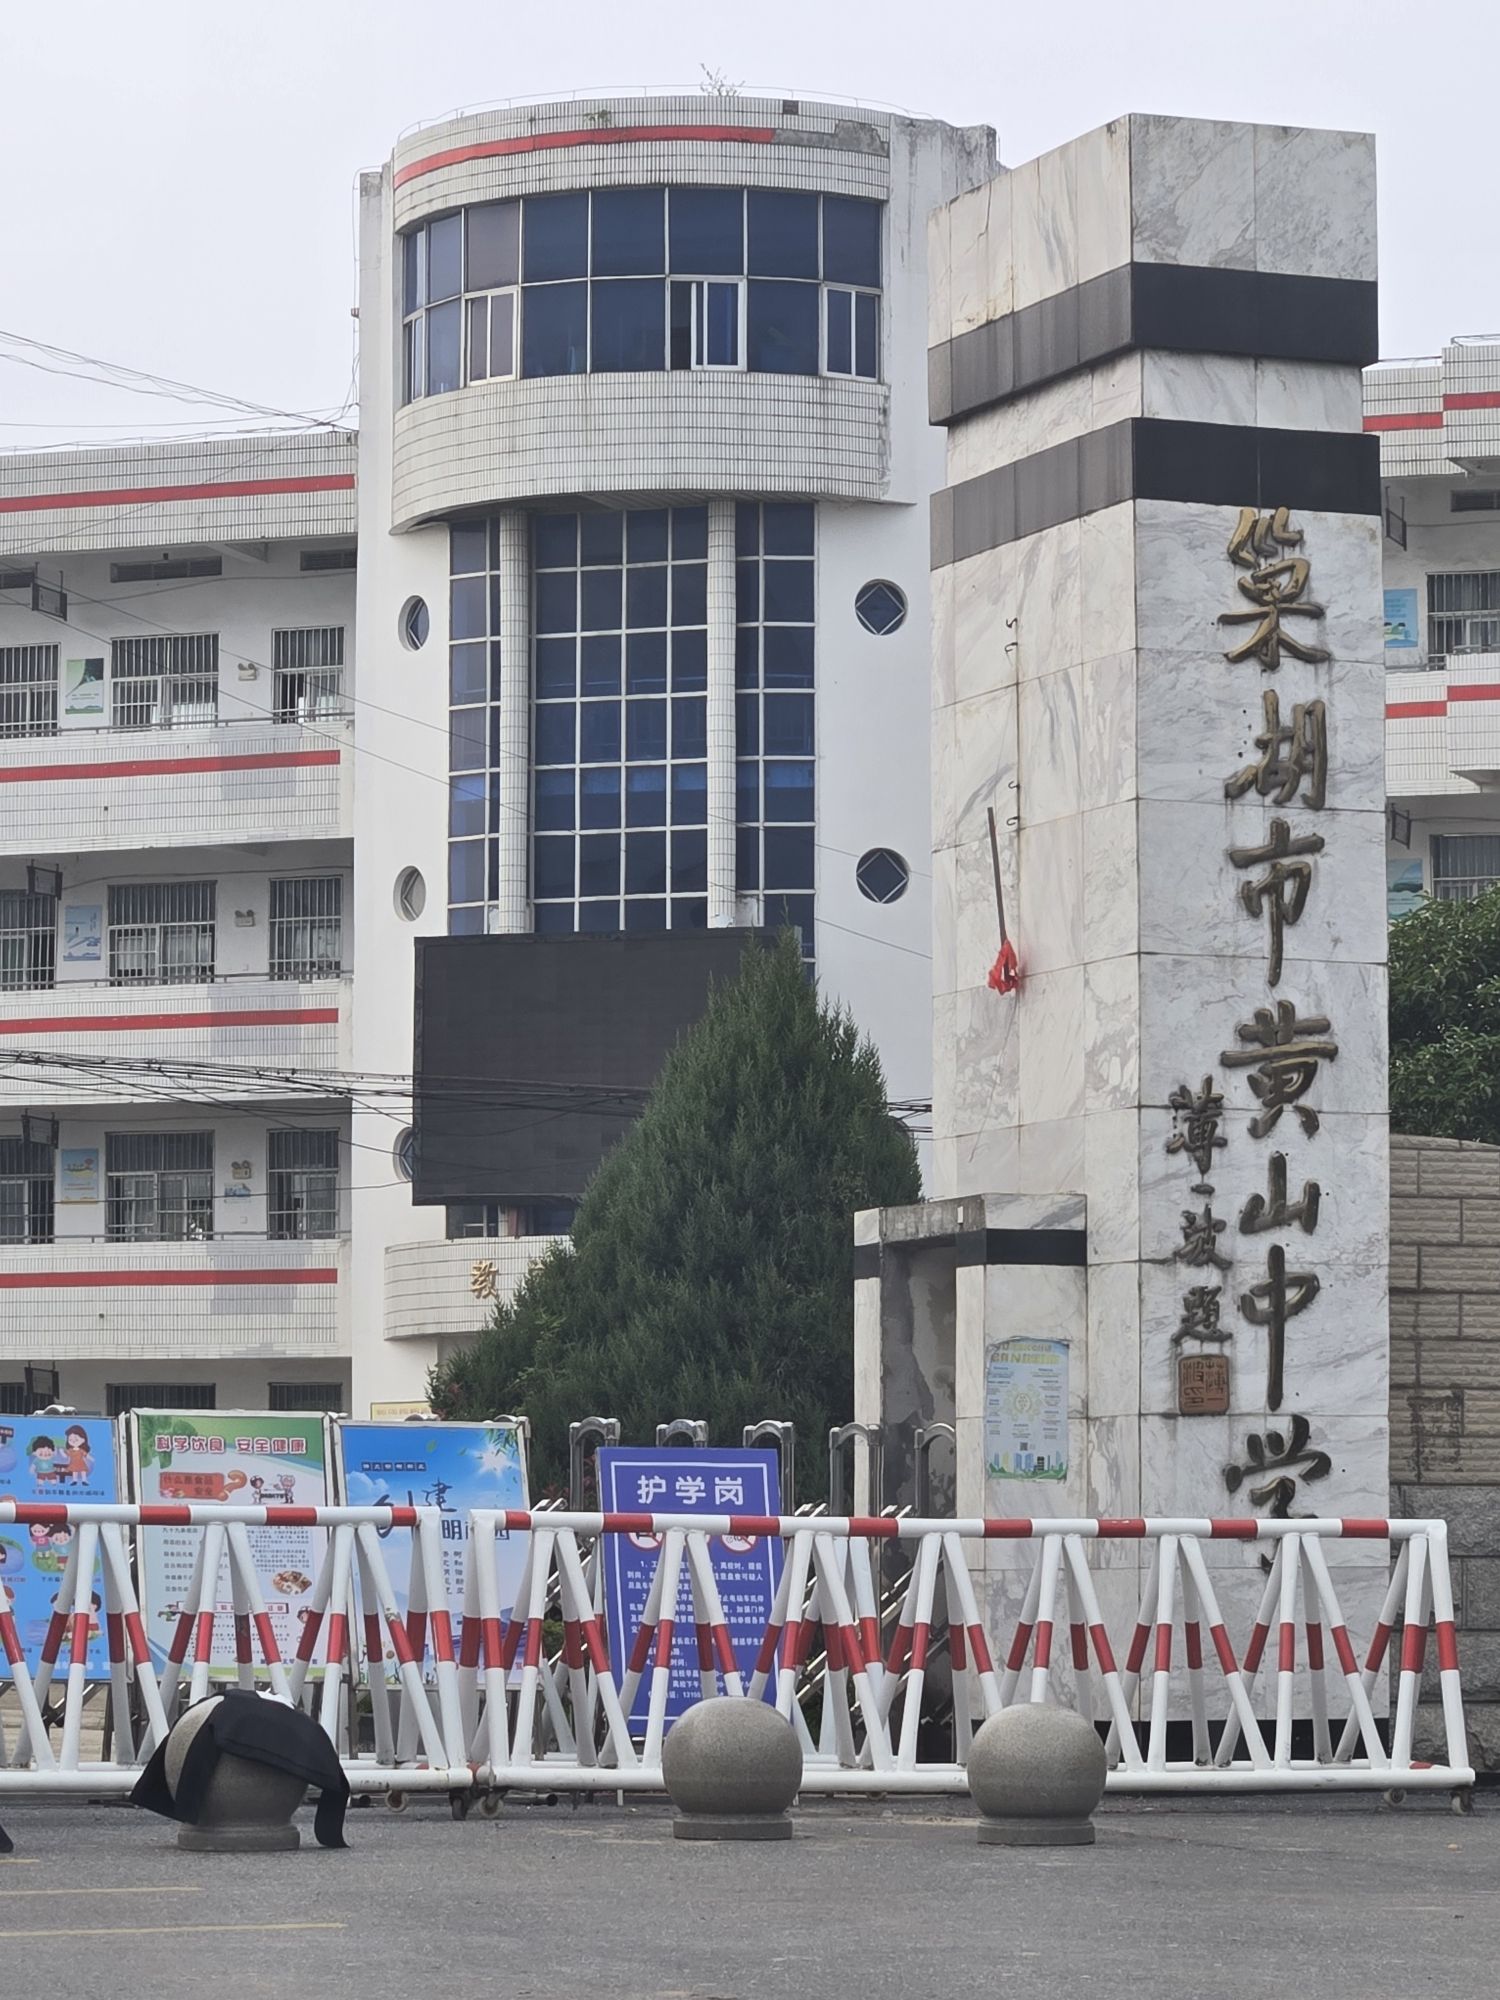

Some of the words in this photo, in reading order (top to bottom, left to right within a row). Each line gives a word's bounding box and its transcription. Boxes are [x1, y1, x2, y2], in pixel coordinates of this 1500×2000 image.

[154, 1434, 226, 1454] 科学饮食
[234, 1436, 308, 1455] 安全健康
[636, 1474, 744, 1506] 护学岗
